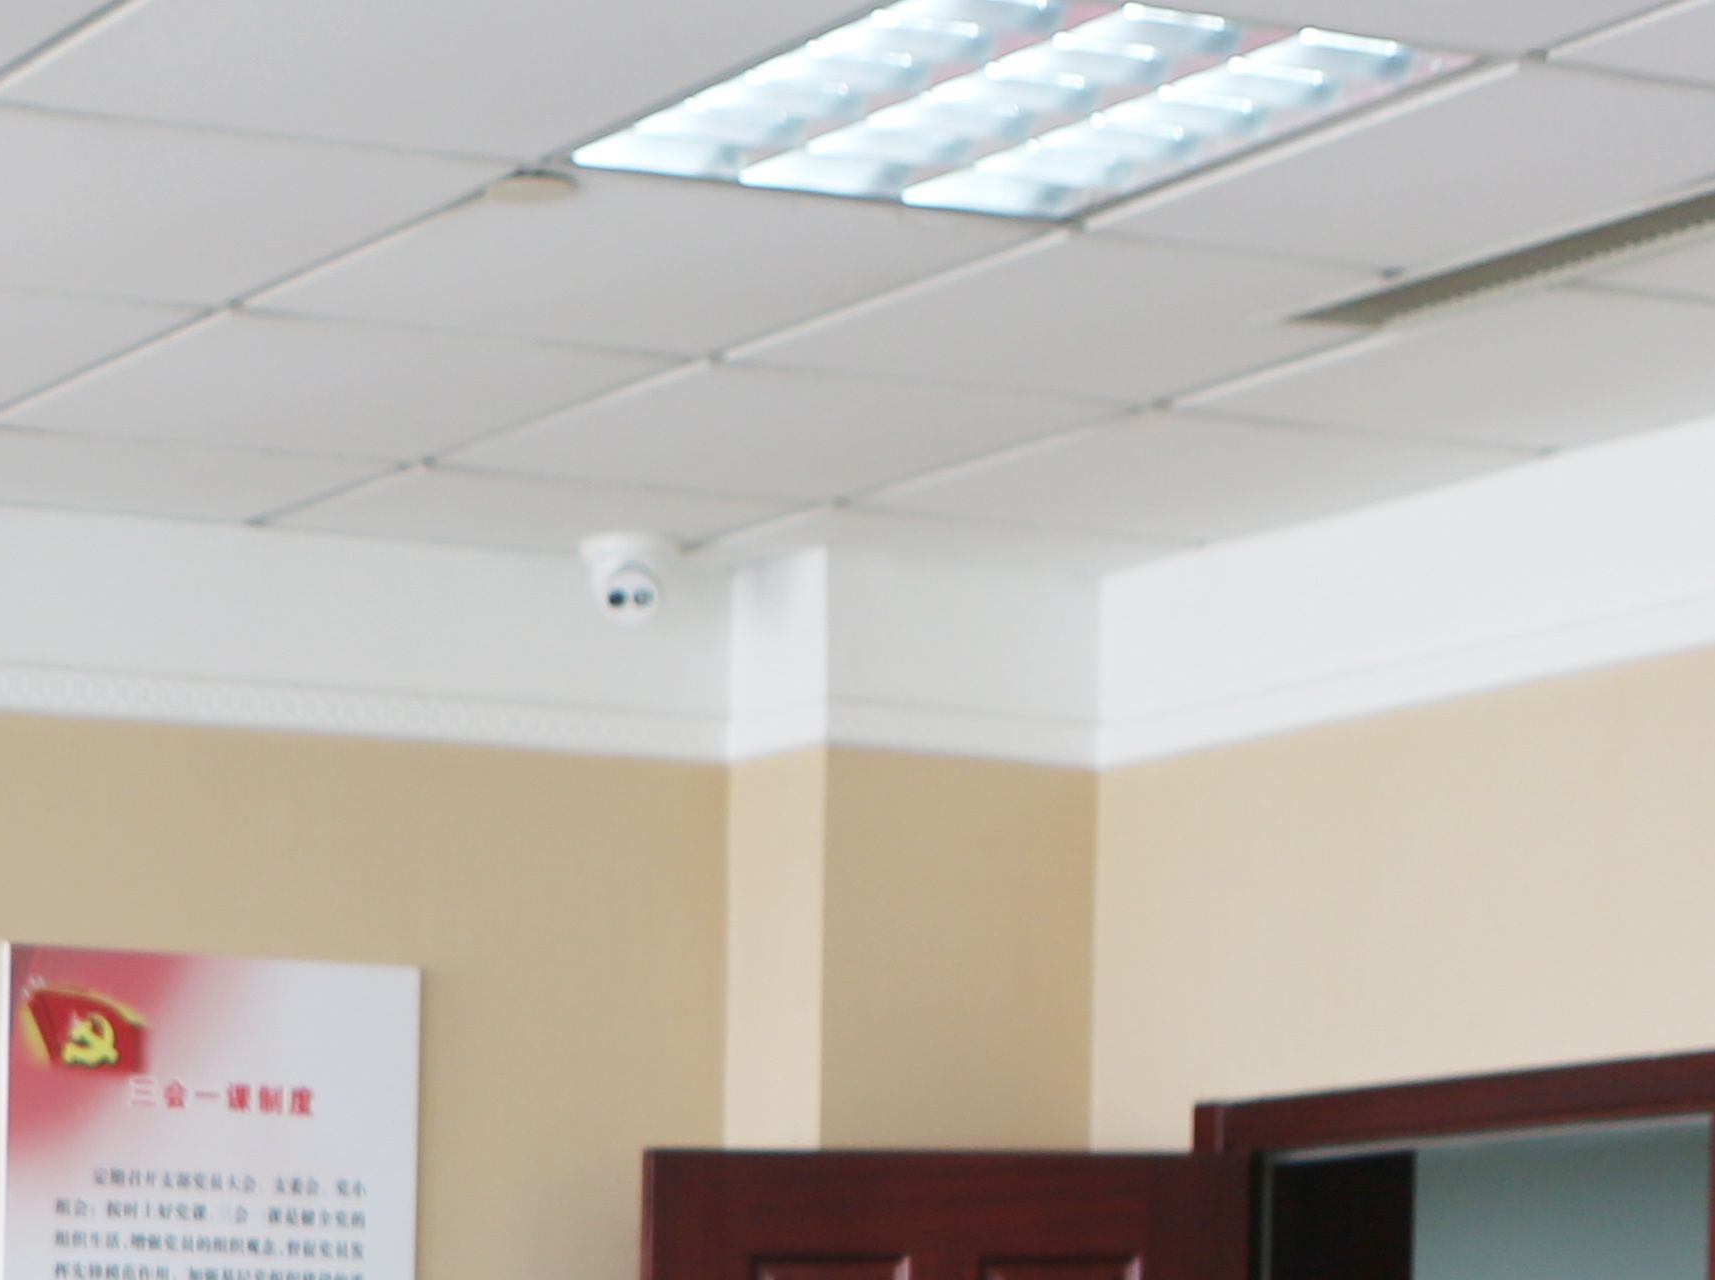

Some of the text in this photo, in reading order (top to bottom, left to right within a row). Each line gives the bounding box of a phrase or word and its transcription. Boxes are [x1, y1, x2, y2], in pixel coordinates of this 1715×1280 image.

[131, 1078, 315, 1118] 三会一课制度
